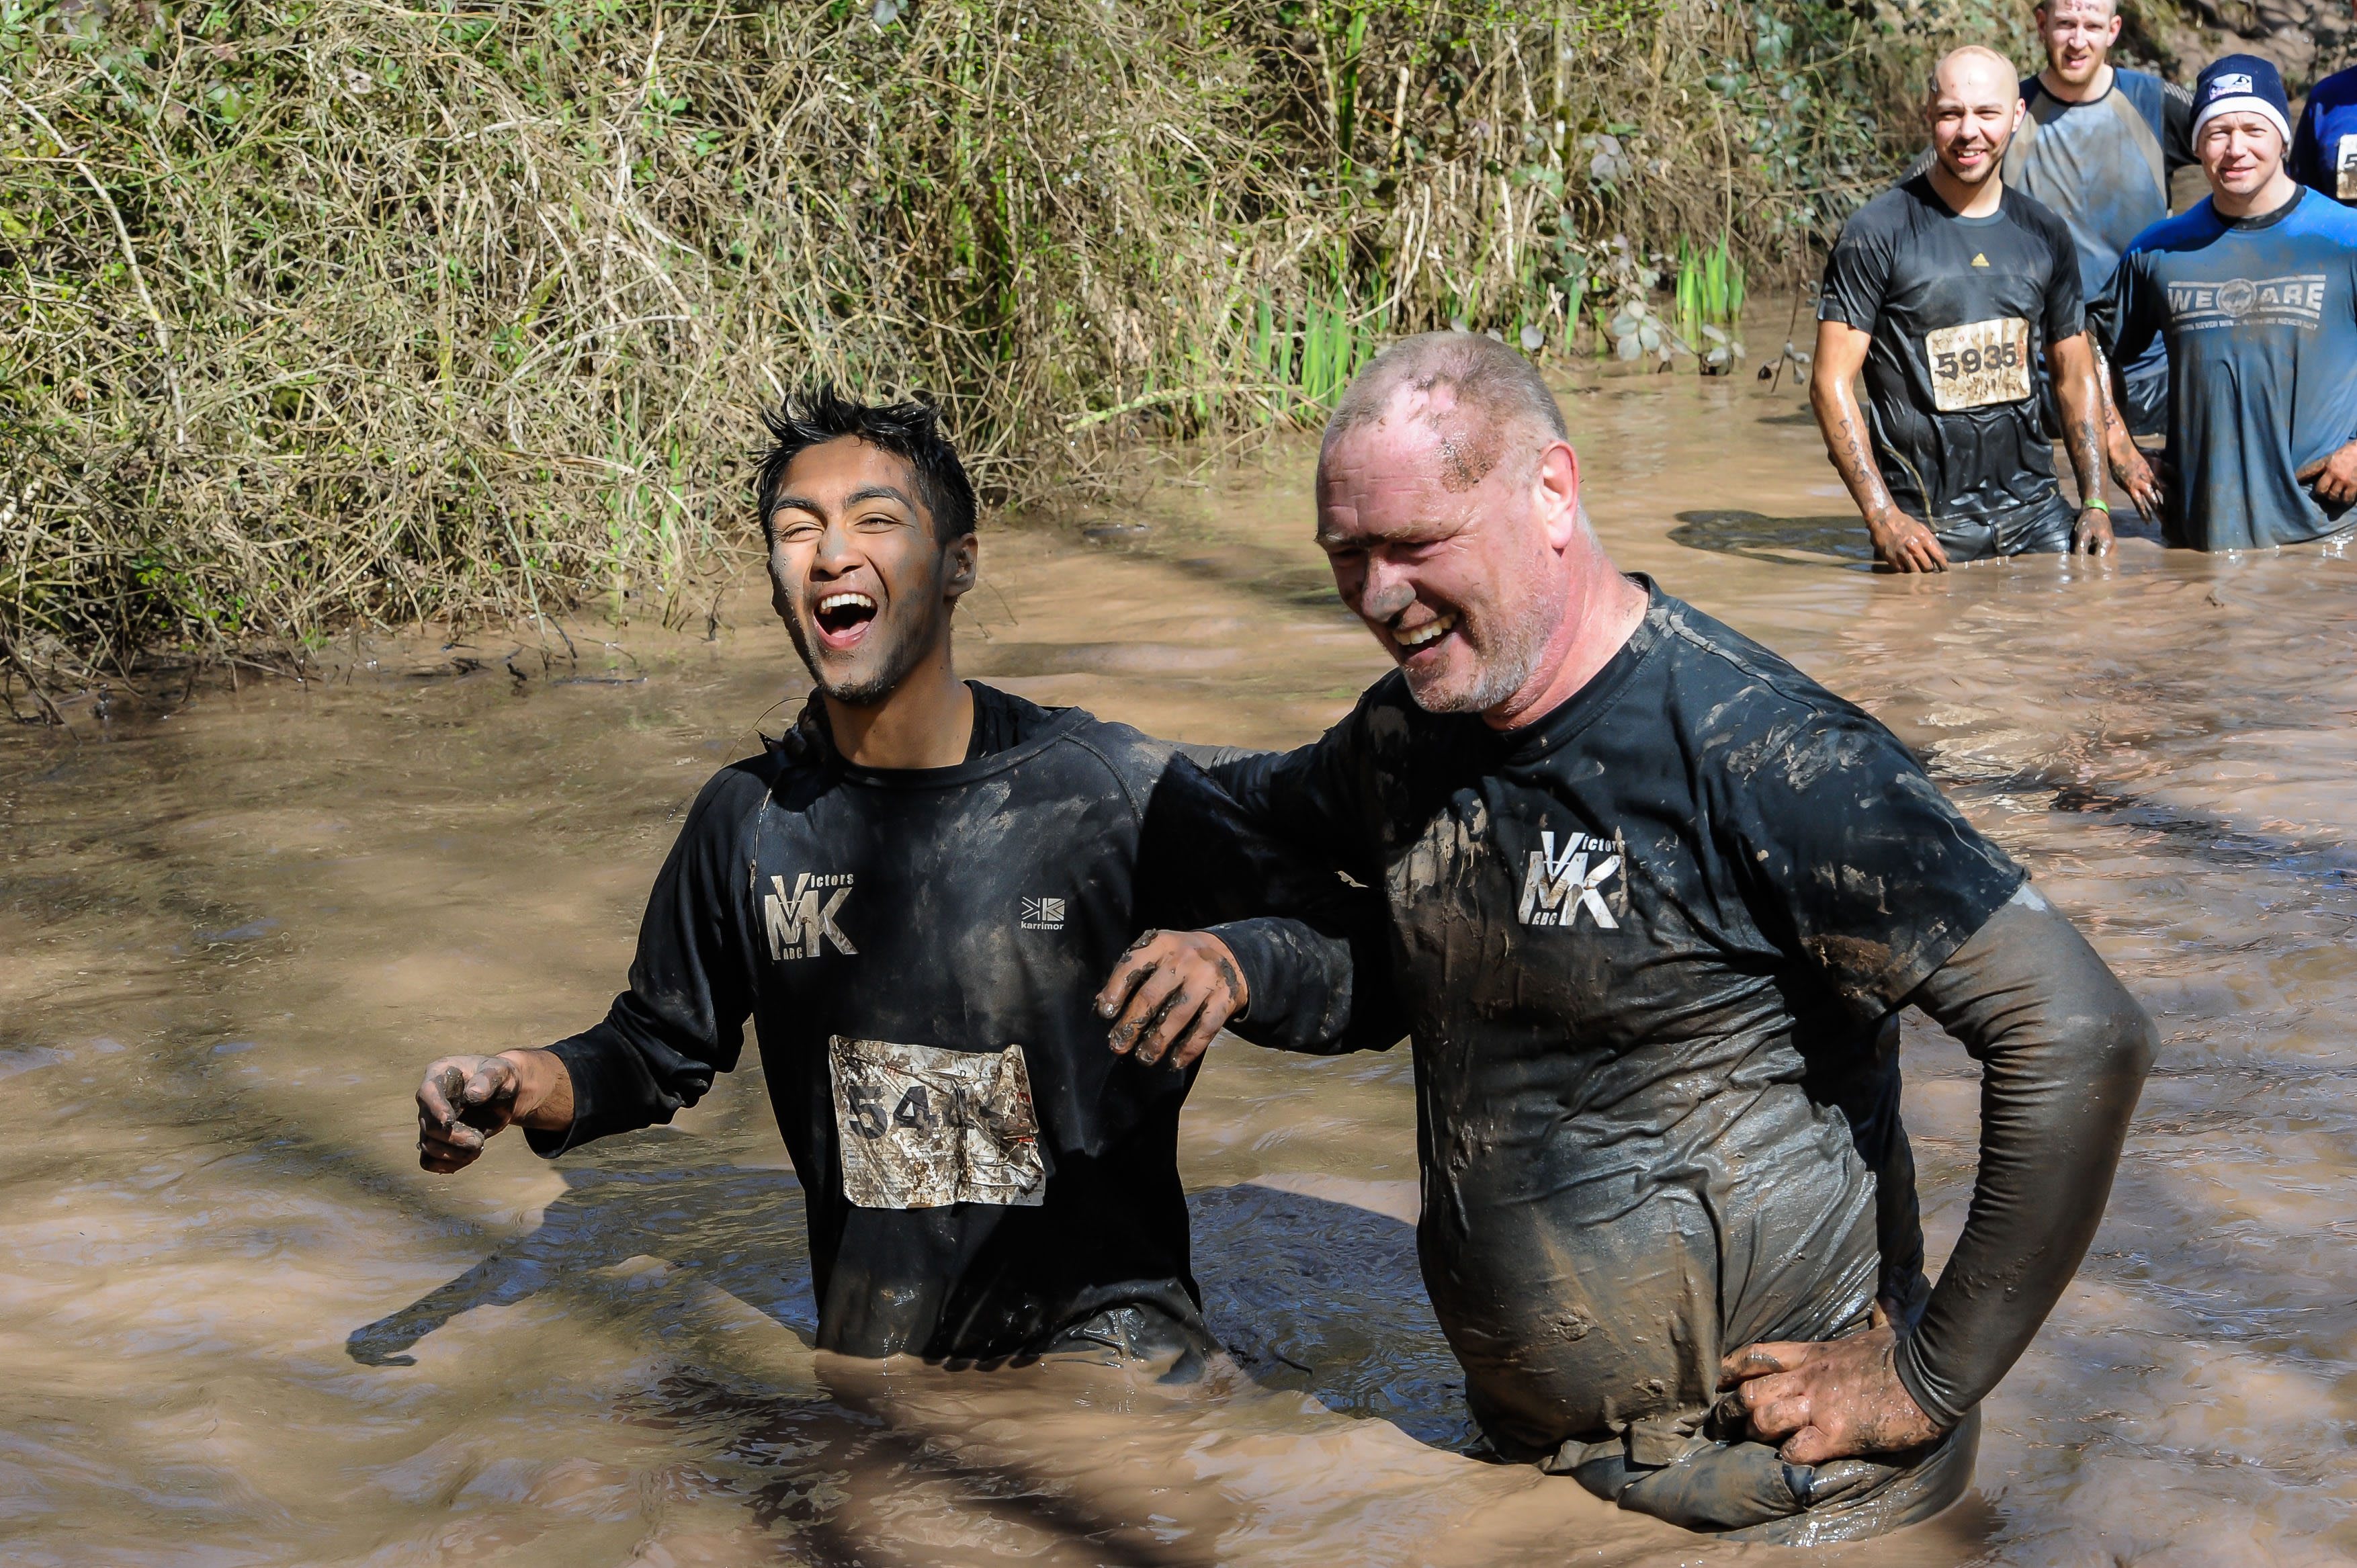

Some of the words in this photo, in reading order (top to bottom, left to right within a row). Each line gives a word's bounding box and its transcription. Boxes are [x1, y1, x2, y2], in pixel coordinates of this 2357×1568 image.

[2168, 288, 2213, 313] WE
[2259, 282, 2325, 311] ARE
[1935, 343, 2016, 380] 5935
[1021, 920, 1064, 930] karrimor
[1532, 912, 1557, 926] ABC
[783, 947, 803, 959] ABC
